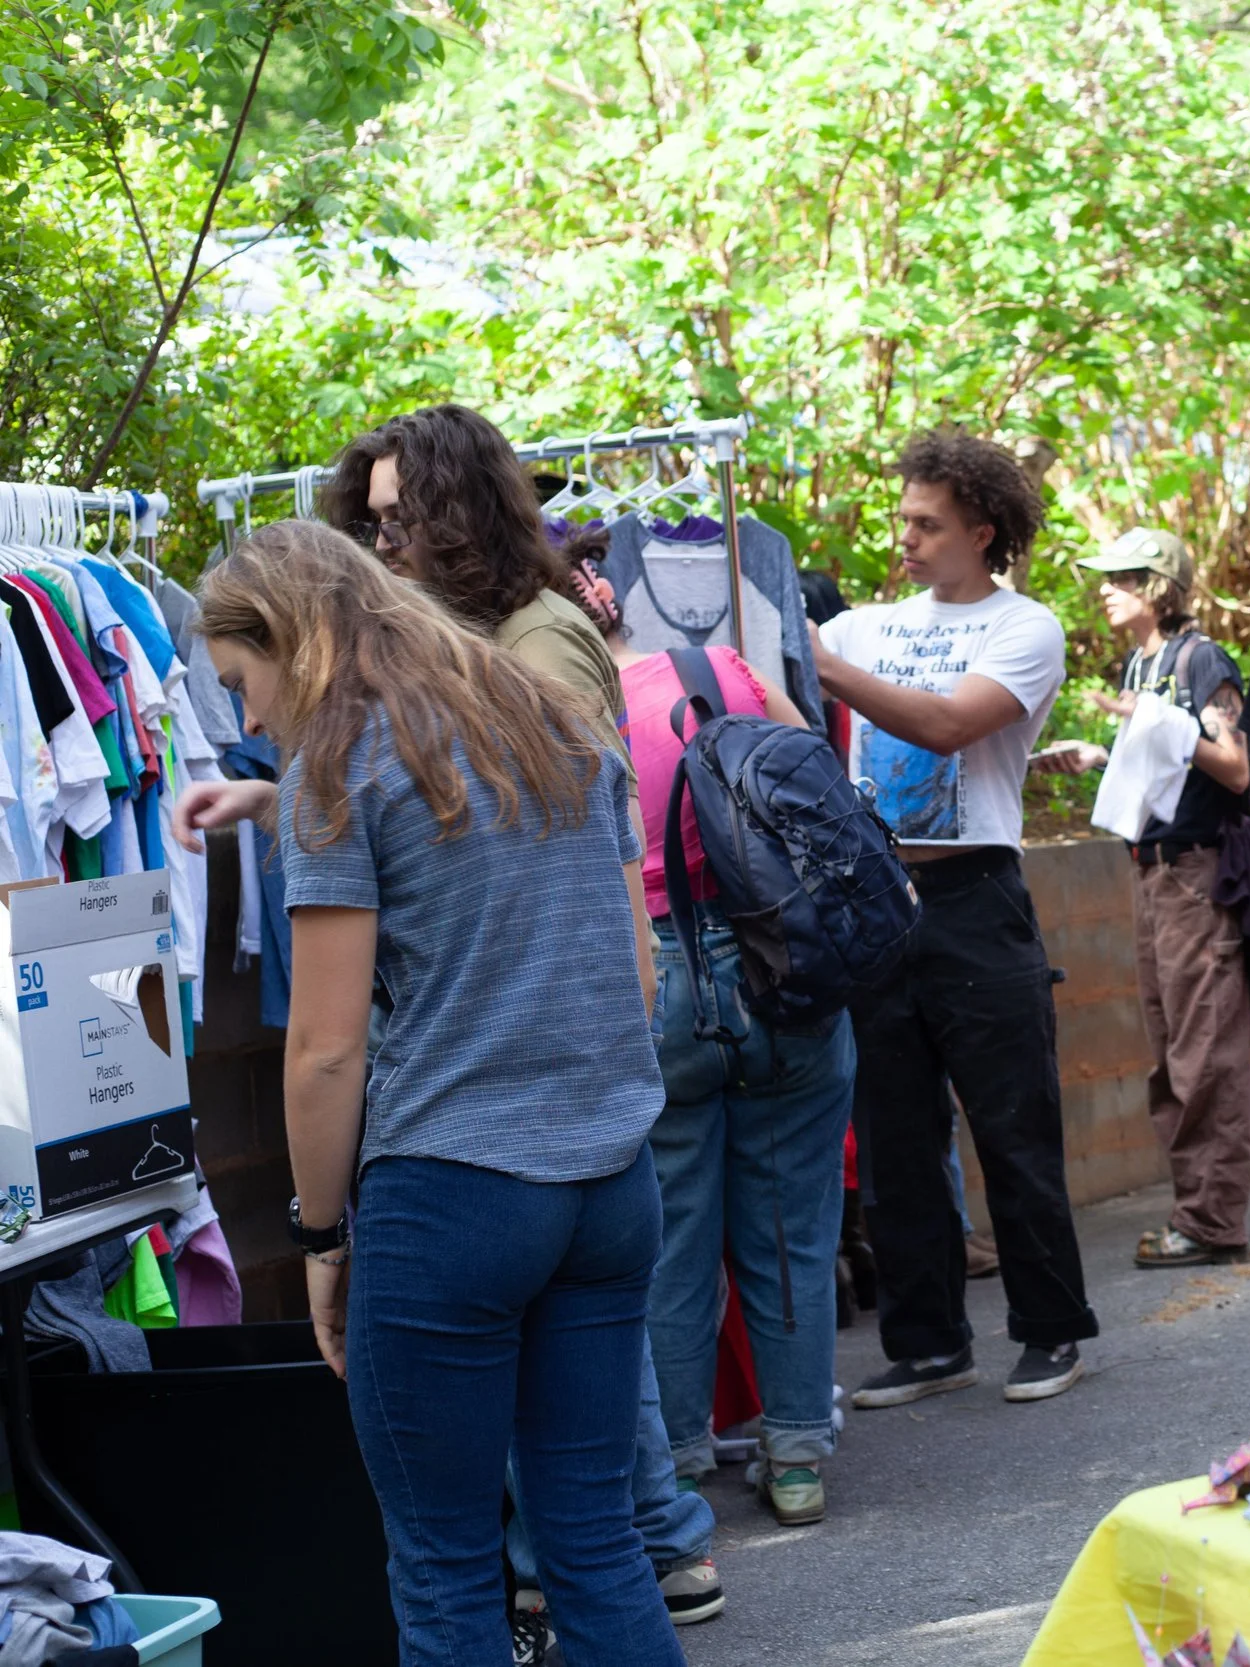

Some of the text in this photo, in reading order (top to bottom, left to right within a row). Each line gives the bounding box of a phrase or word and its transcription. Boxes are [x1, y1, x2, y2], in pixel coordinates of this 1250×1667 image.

[88, 880, 110, 892] Plastic
[80, 894, 118, 912] Hangers
[19, 962, 44, 992] 50
[28, 996, 41, 1008] pack
[88, 1025, 130, 1043] MAINSTAYS
[96, 1061, 123, 1081] Plastic
[89, 1081, 135, 1104] Hangers
[68, 1148, 90, 1161] White
[19, 1185, 36, 1208] 50
